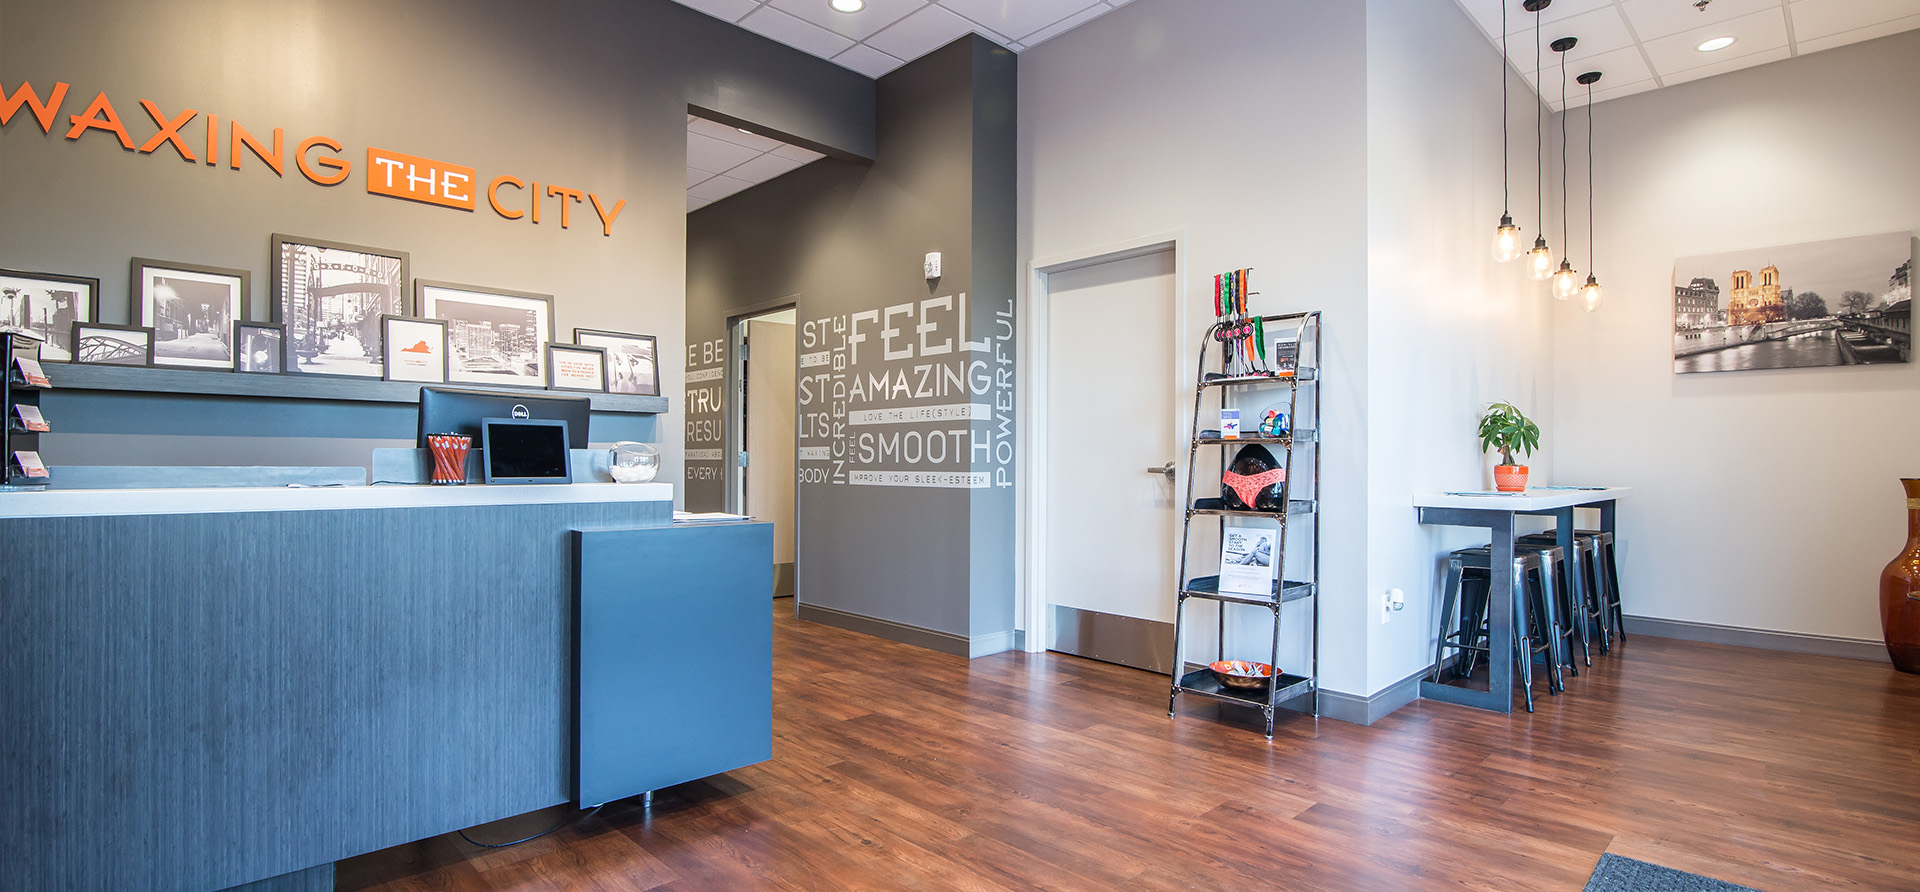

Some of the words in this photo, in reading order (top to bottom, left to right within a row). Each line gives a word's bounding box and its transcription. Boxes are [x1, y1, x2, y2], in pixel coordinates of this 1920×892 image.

[0, 80, 352, 186] WAXING
[375, 157, 469, 202] THE
[487, 174, 628, 236] CITY
[803, 317, 831, 348] ST
[848, 292, 991, 365] FEEL
[800, 373, 830, 405] ST
[848, 360, 992, 403] AMAZING
[996, 299, 1013, 489] POWERFUL
[833, 315, 846, 484] INCREDIBLE
[863, 413, 883, 421] LOVE
[888, 411, 903, 420] THE
[909, 408, 972, 419] LIFE(STYLE)
[686, 419, 722, 442] RESU
[799, 412, 830, 438] LTS
[858, 429, 991, 464] SMOOTH
[687, 467, 717, 480] EVERY
[800, 468, 830, 483] BODY
[850, 474, 883, 483] IMPROVE
[888, 475, 909, 483] YOUR
[915, 475, 985, 484] SLEEK-ESTEEM
